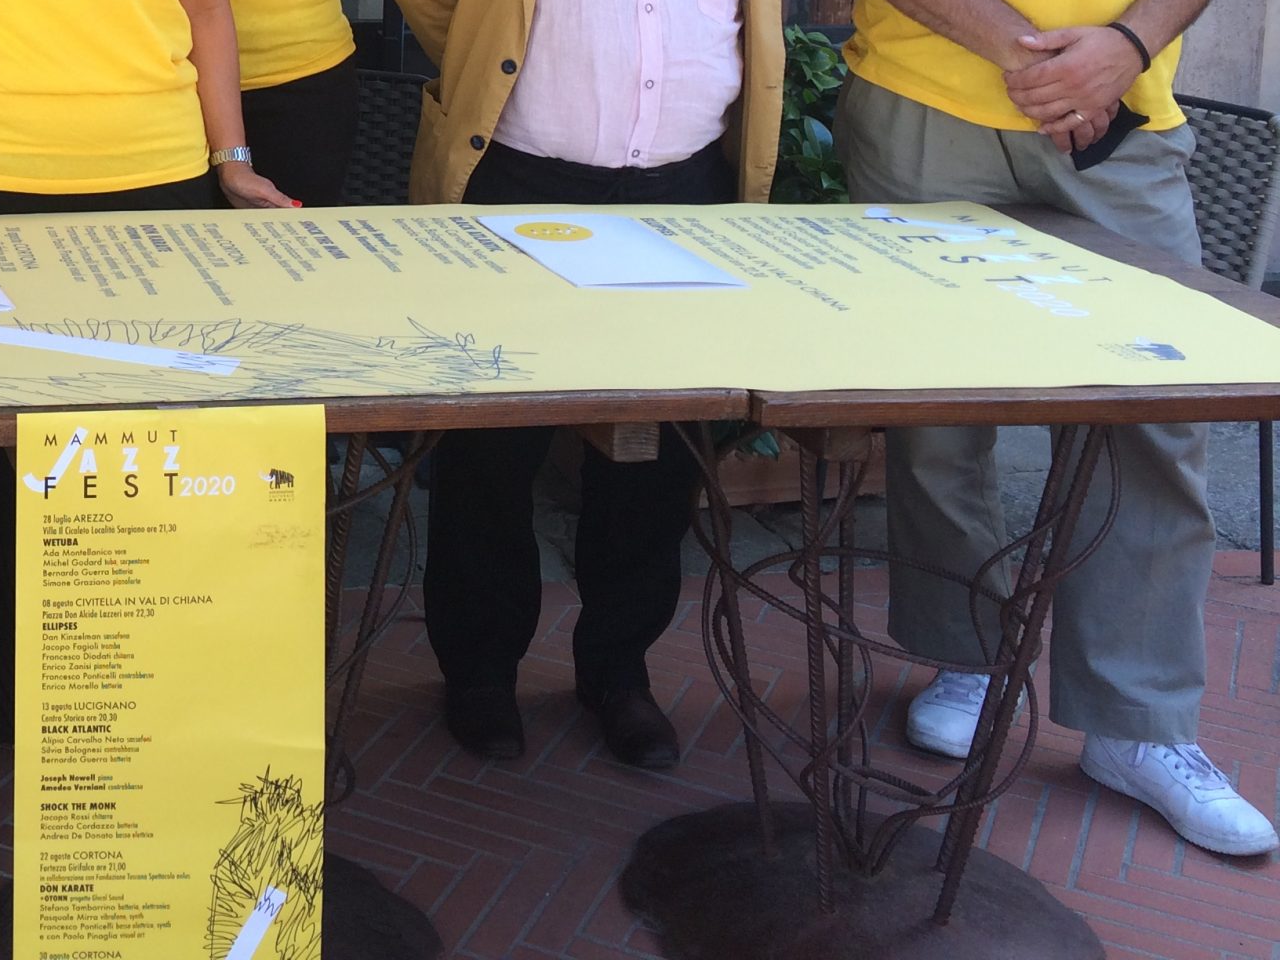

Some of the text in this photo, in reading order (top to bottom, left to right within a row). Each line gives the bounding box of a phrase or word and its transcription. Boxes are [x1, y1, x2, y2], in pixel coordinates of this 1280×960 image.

[44, 430, 178, 447] MAMMUT
[44, 472, 236, 500] FEST 2020
[43, 514, 114, 525] 28 luglio AREZZO
[43, 526, 57, 535] Villa
[59, 526, 63, 535] Il
[65, 526, 89, 535] Cicaleto
[159, 524, 177, 534] 21,30
[43, 538, 78, 547] WETUBA
[62, 548, 112, 557] Montellanico
[43, 559, 69, 567] Michel
[43, 569, 78, 577] Bernardo
[43, 596, 212, 609] 08 agosto CIVITELLA IN VAL DI CHIANA
[43, 611, 63, 619] Piazza
[65, 611, 77, 619] Don
[79, 610, 97, 618] Alcide
[100, 610, 122, 618] Lazzeri
[136, 609, 155, 619] 22,30
[43, 622, 77, 631] ELLIPSES
[42, 701, 136, 713] 13 agosto LUCIGNANO
[42, 725, 111, 734] BLACK ATLANTIC
[67, 736, 102, 744] Carvalho
[40, 803, 68, 811] SHOCK
[90, 802, 117, 810] MONK
[40, 814, 68, 822] Jacopo
[40, 851, 123, 862] 22 agosto CORTONA
[40, 884, 94, 893] DON KARATE
